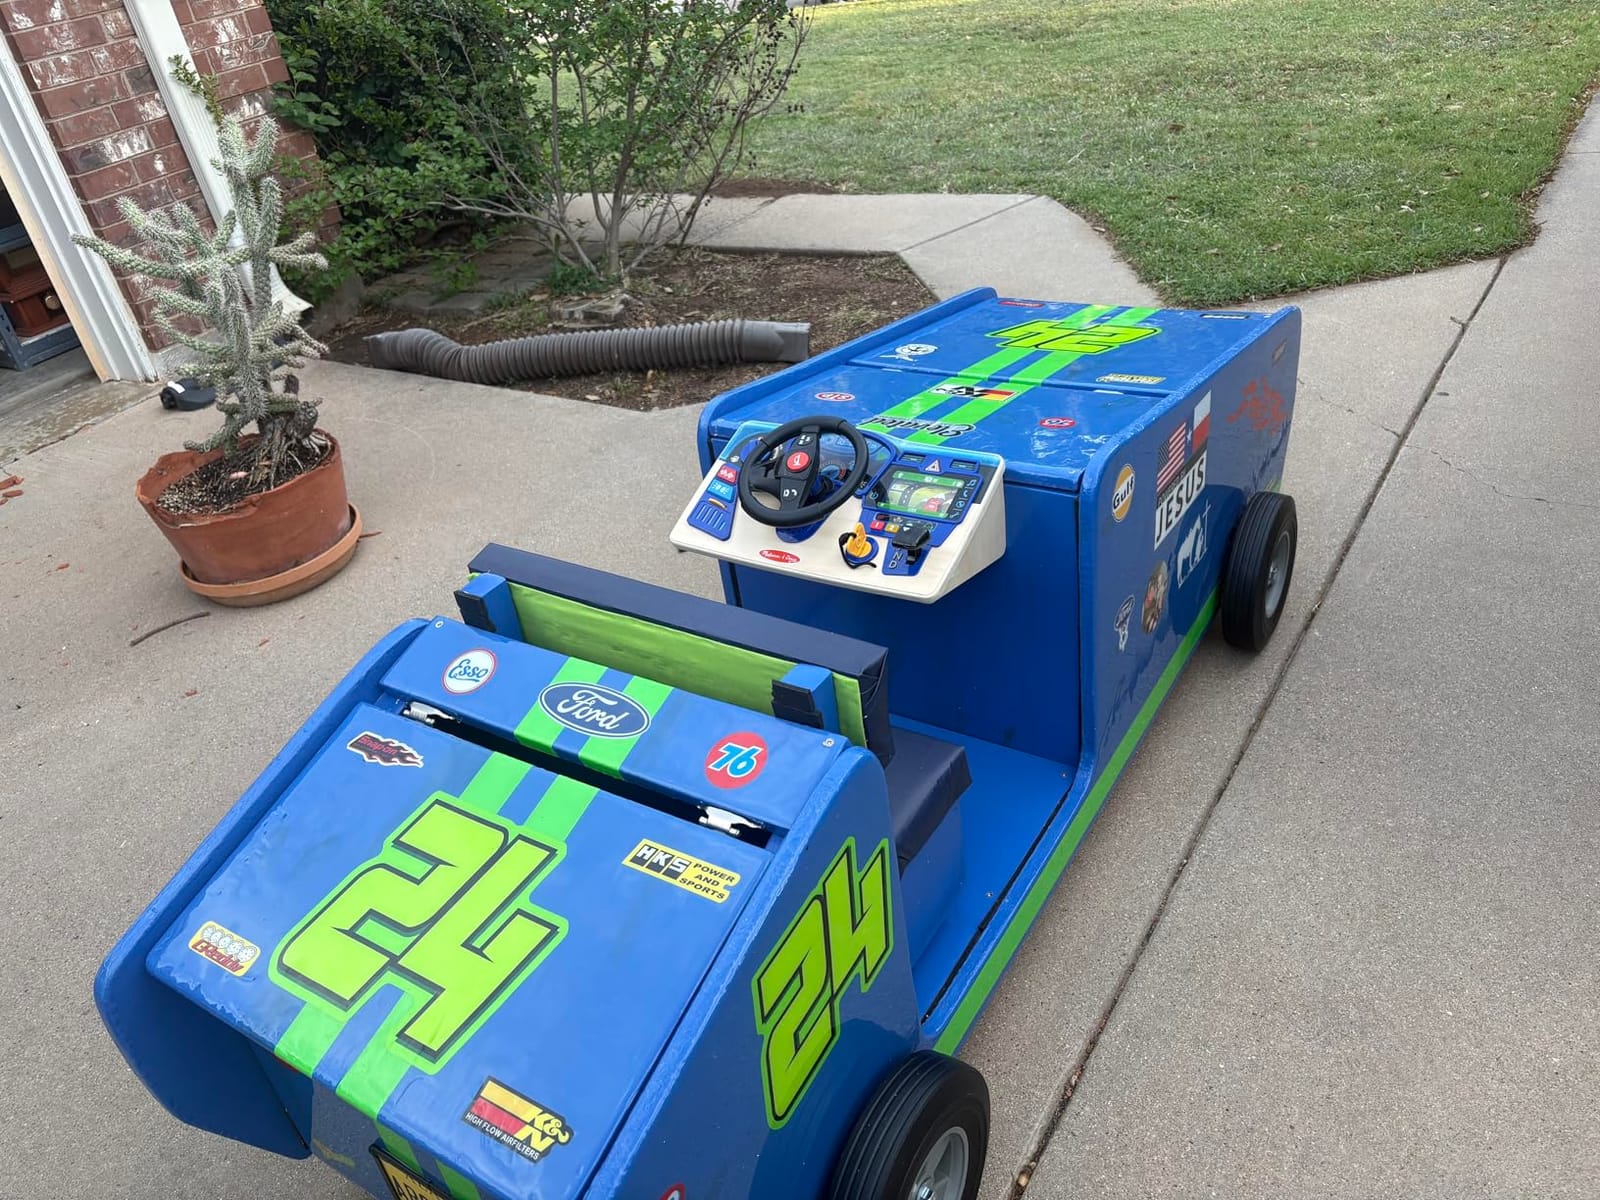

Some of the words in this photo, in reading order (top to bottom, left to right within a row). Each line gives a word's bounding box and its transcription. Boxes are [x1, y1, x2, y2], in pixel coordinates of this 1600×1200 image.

[861, 416, 974, 438] Elevated
[1113, 475, 1134, 510] Gulf
[1156, 457, 1205, 543] JESUS
[447, 658, 489, 683] Esso
[556, 689, 630, 730] Ford
[707, 741, 764, 778] 76
[635, 844, 691, 874] HKS
[693, 862, 736, 883] POWER
[678, 877, 726, 900] SPORTS
[694, 874, 720, 887] AND
[275, 796, 562, 1067] 24
[756, 843, 891, 1123] 24
[464, 1111, 483, 1128] HIGH
[482, 1122, 502, 1140] FLOW
[513, 1108, 570, 1153] K&N
